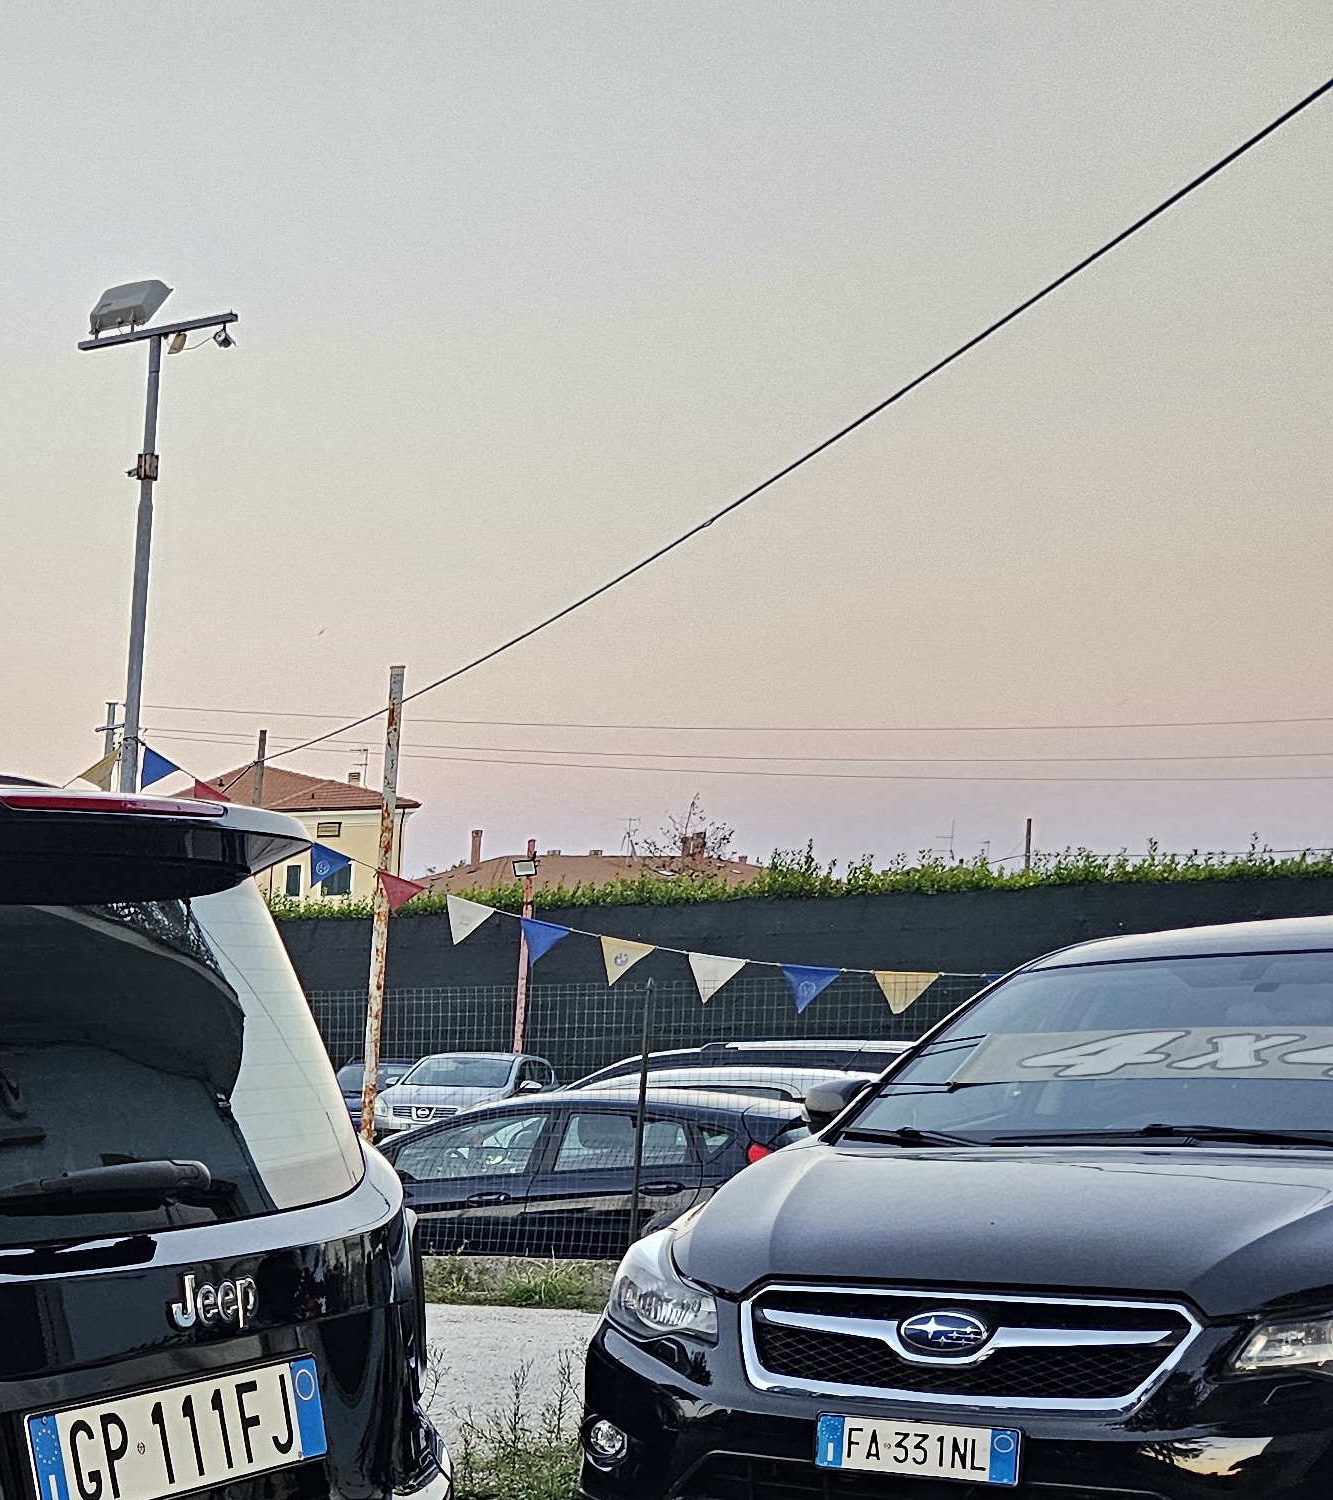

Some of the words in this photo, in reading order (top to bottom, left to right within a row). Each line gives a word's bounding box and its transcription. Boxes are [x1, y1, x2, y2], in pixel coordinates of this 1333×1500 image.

[171, 1273, 259, 1330] Jeep
[150, 1373, 295, 1485] 111FJ
[846, 1427, 881, 1461] FA
[892, 1431, 987, 1472] 331NL
